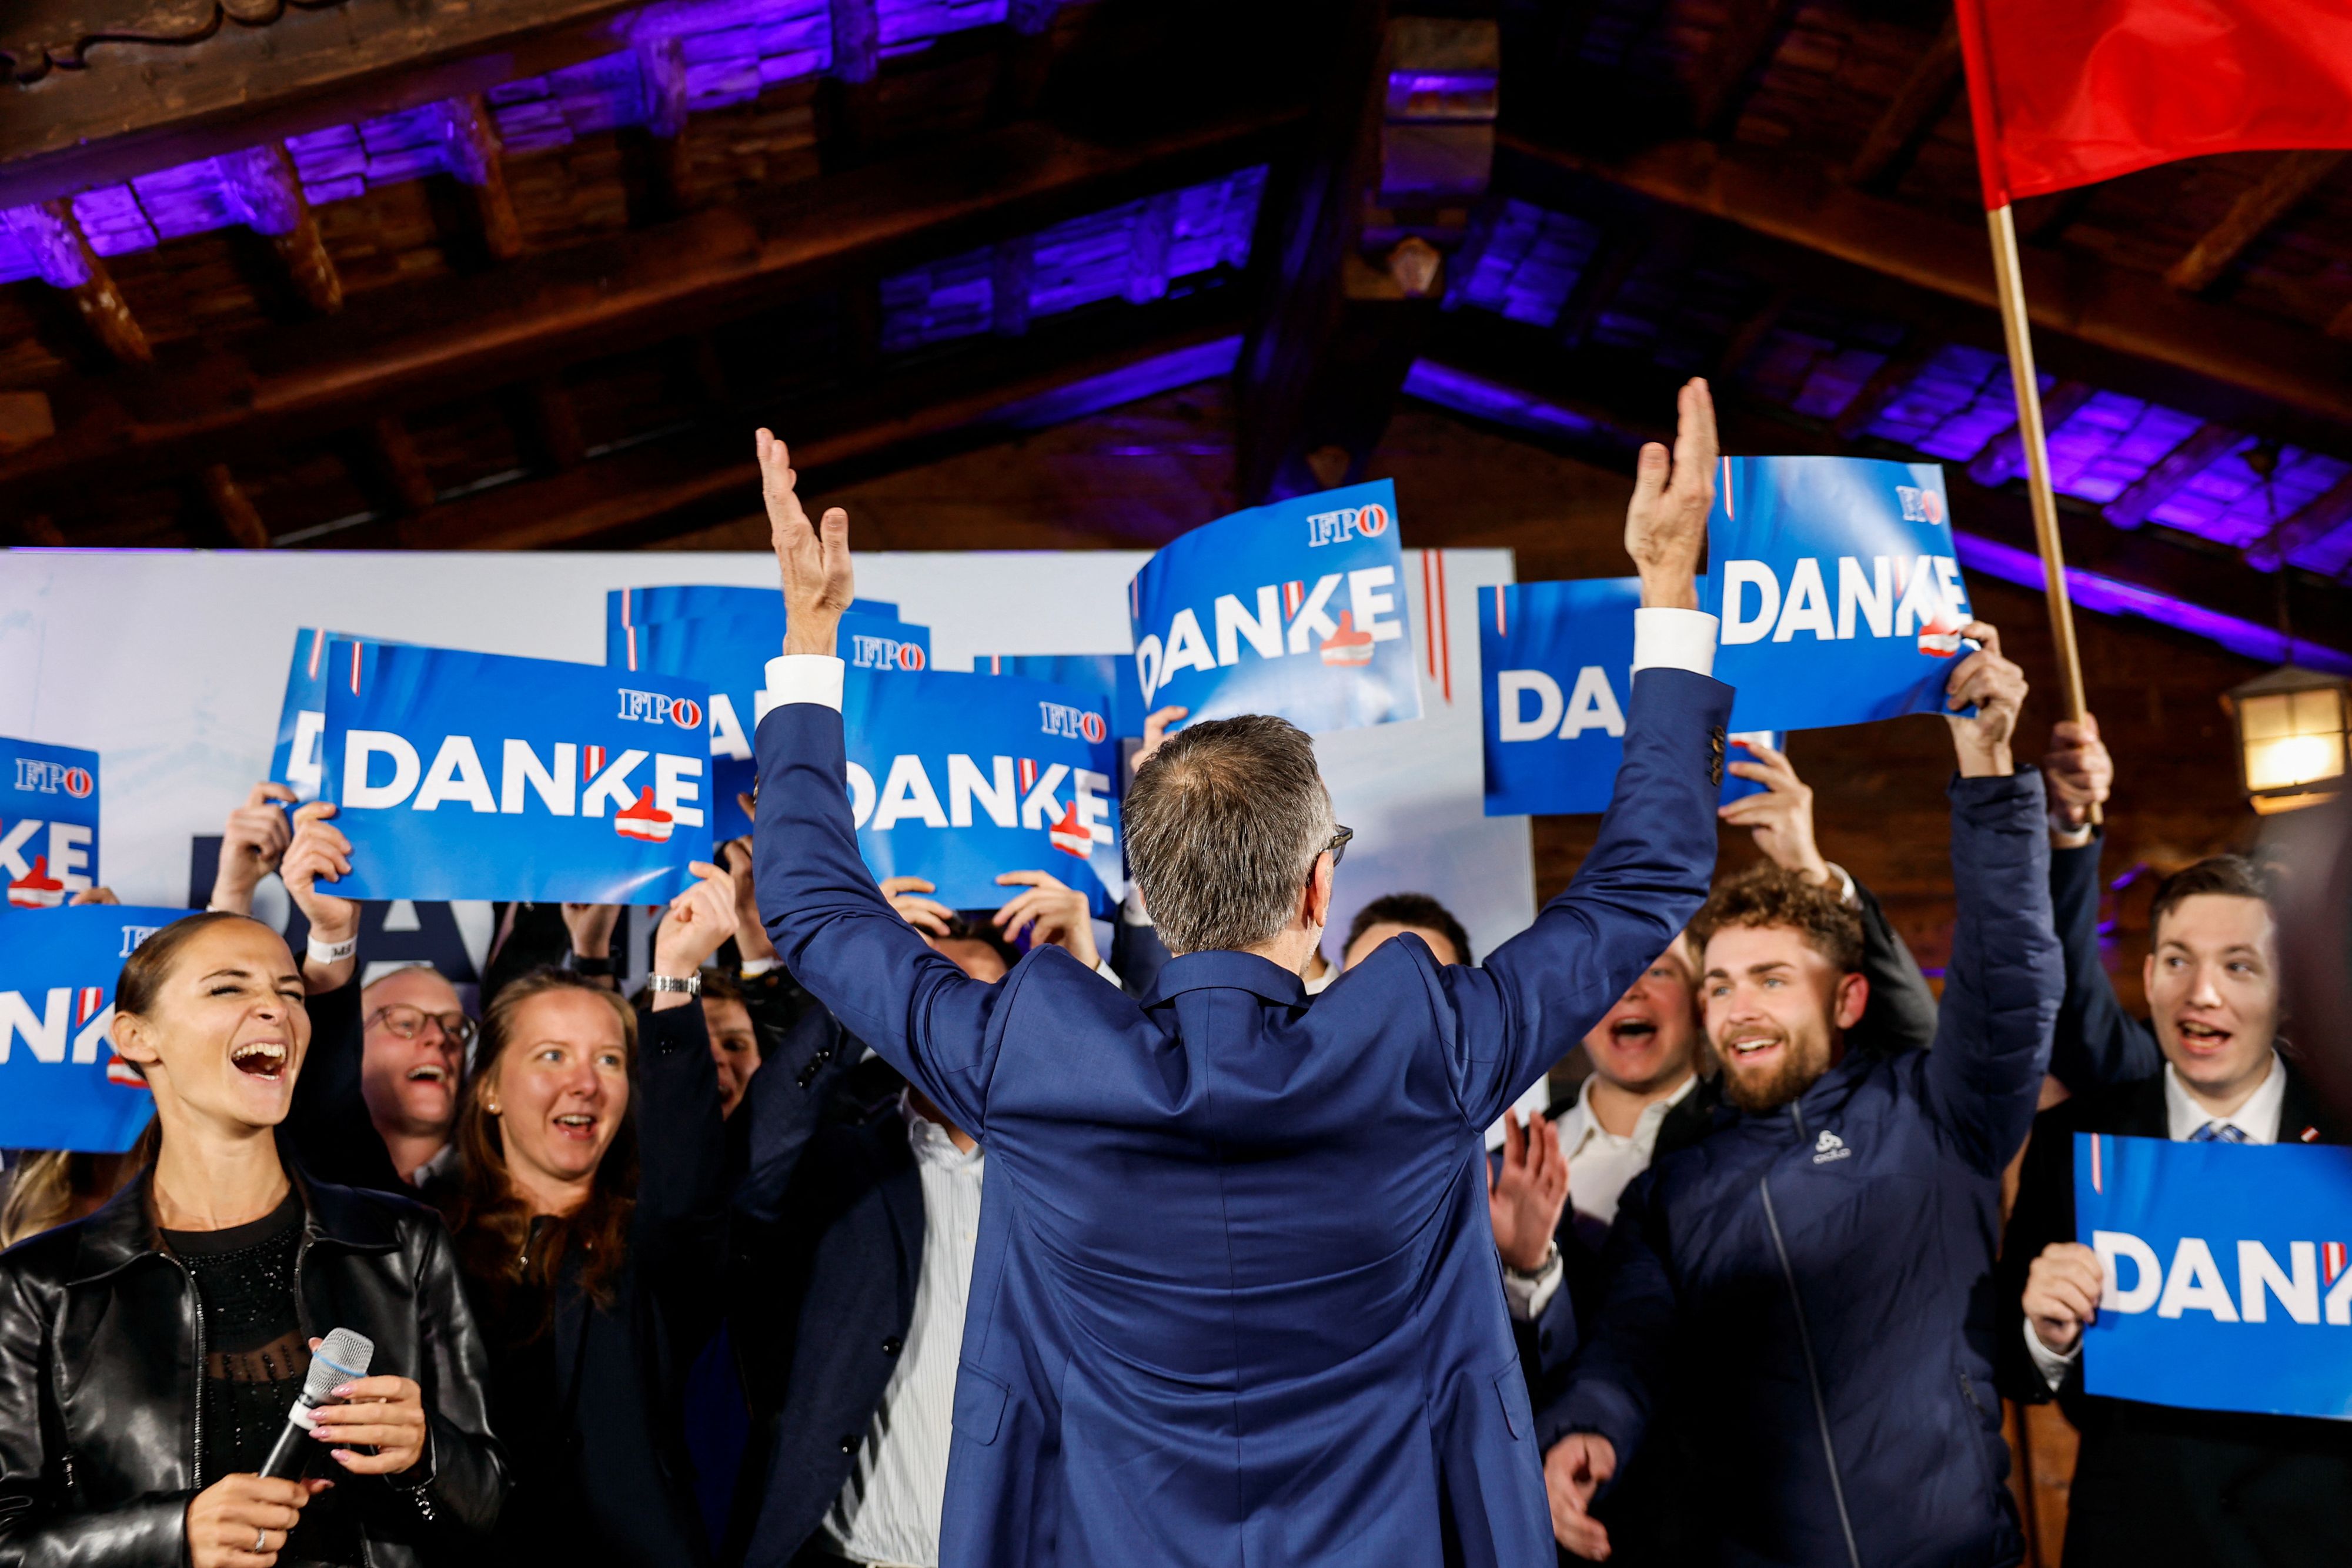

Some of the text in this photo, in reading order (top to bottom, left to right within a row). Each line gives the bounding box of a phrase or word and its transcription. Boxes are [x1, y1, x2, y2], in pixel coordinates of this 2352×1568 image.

[1135, 566, 1402, 710] DANKE
[1720, 556, 1973, 646] DANKE
[1498, 666, 1635, 743] DA
[342, 729, 704, 828] DANKE
